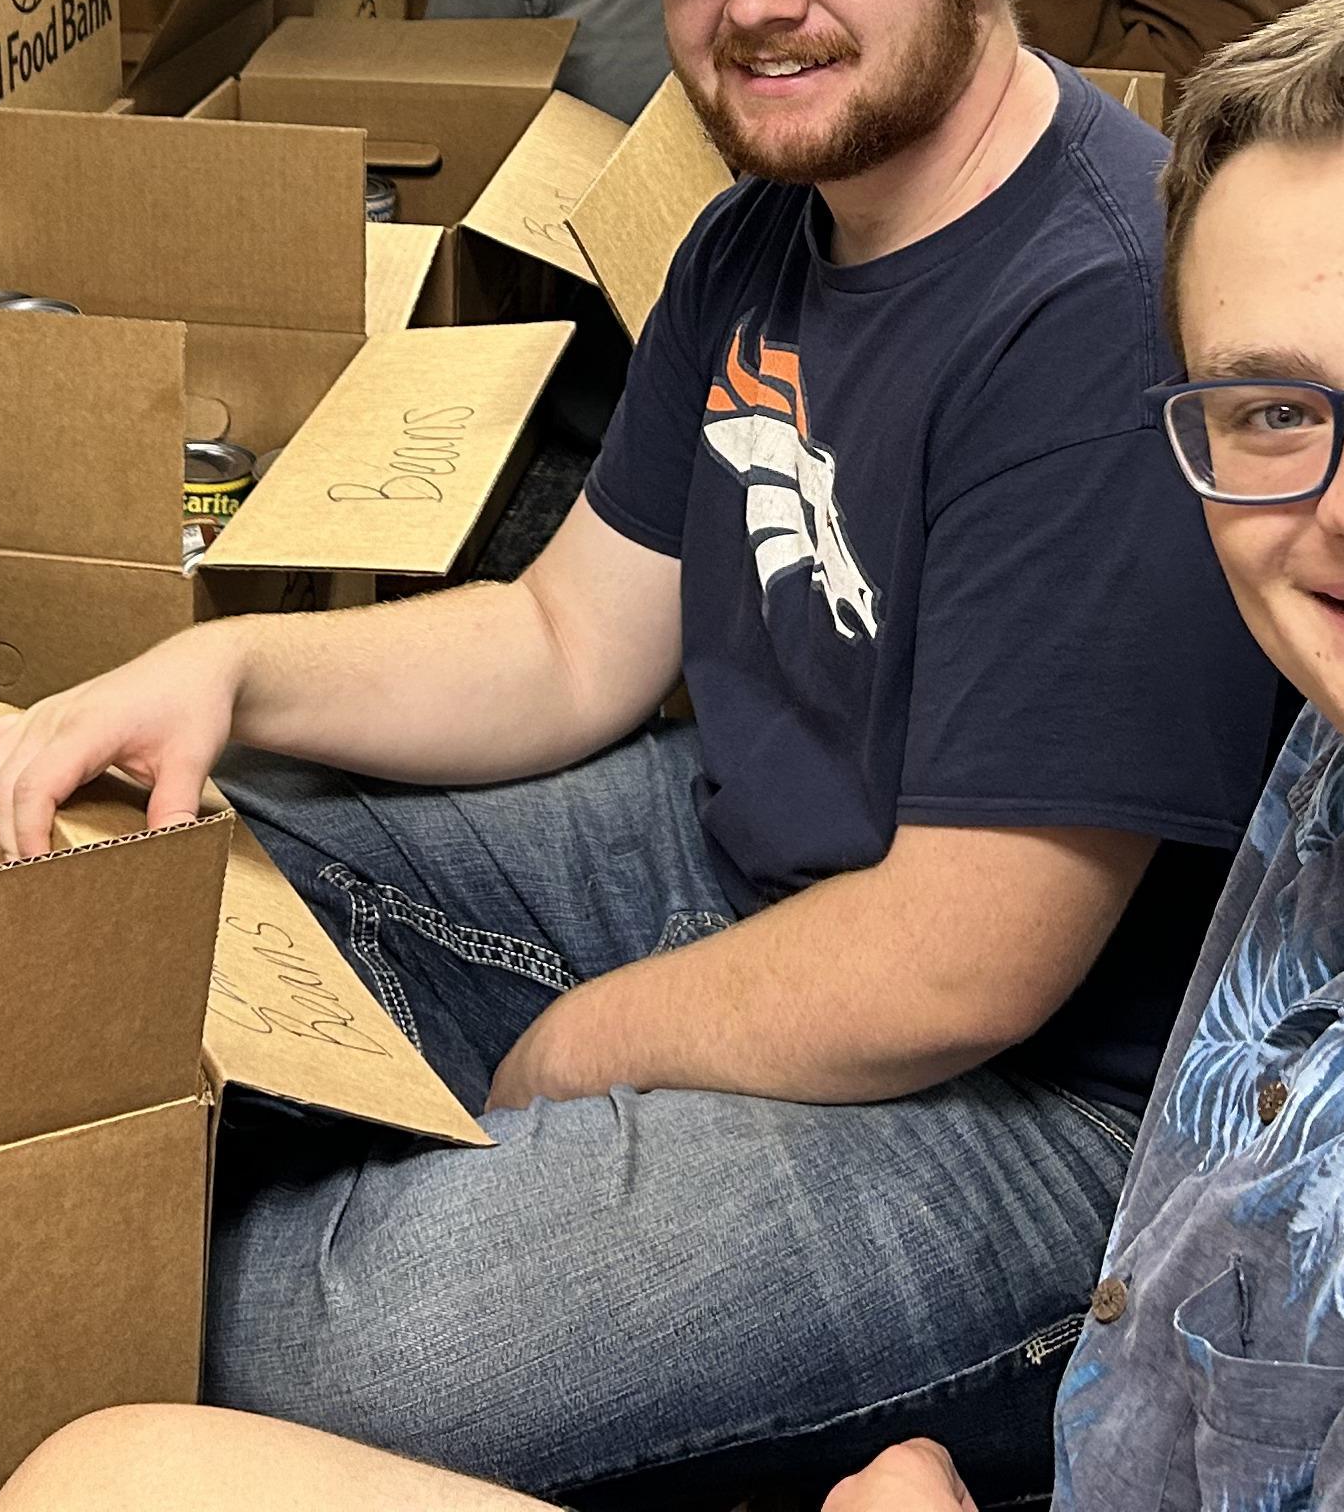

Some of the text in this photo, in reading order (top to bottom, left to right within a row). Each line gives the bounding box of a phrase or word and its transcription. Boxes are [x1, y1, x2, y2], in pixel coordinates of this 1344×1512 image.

[7, 3, 58, 93] Food
[326, 404, 476, 504] Beans
[225, 914, 393, 1059] Beans
